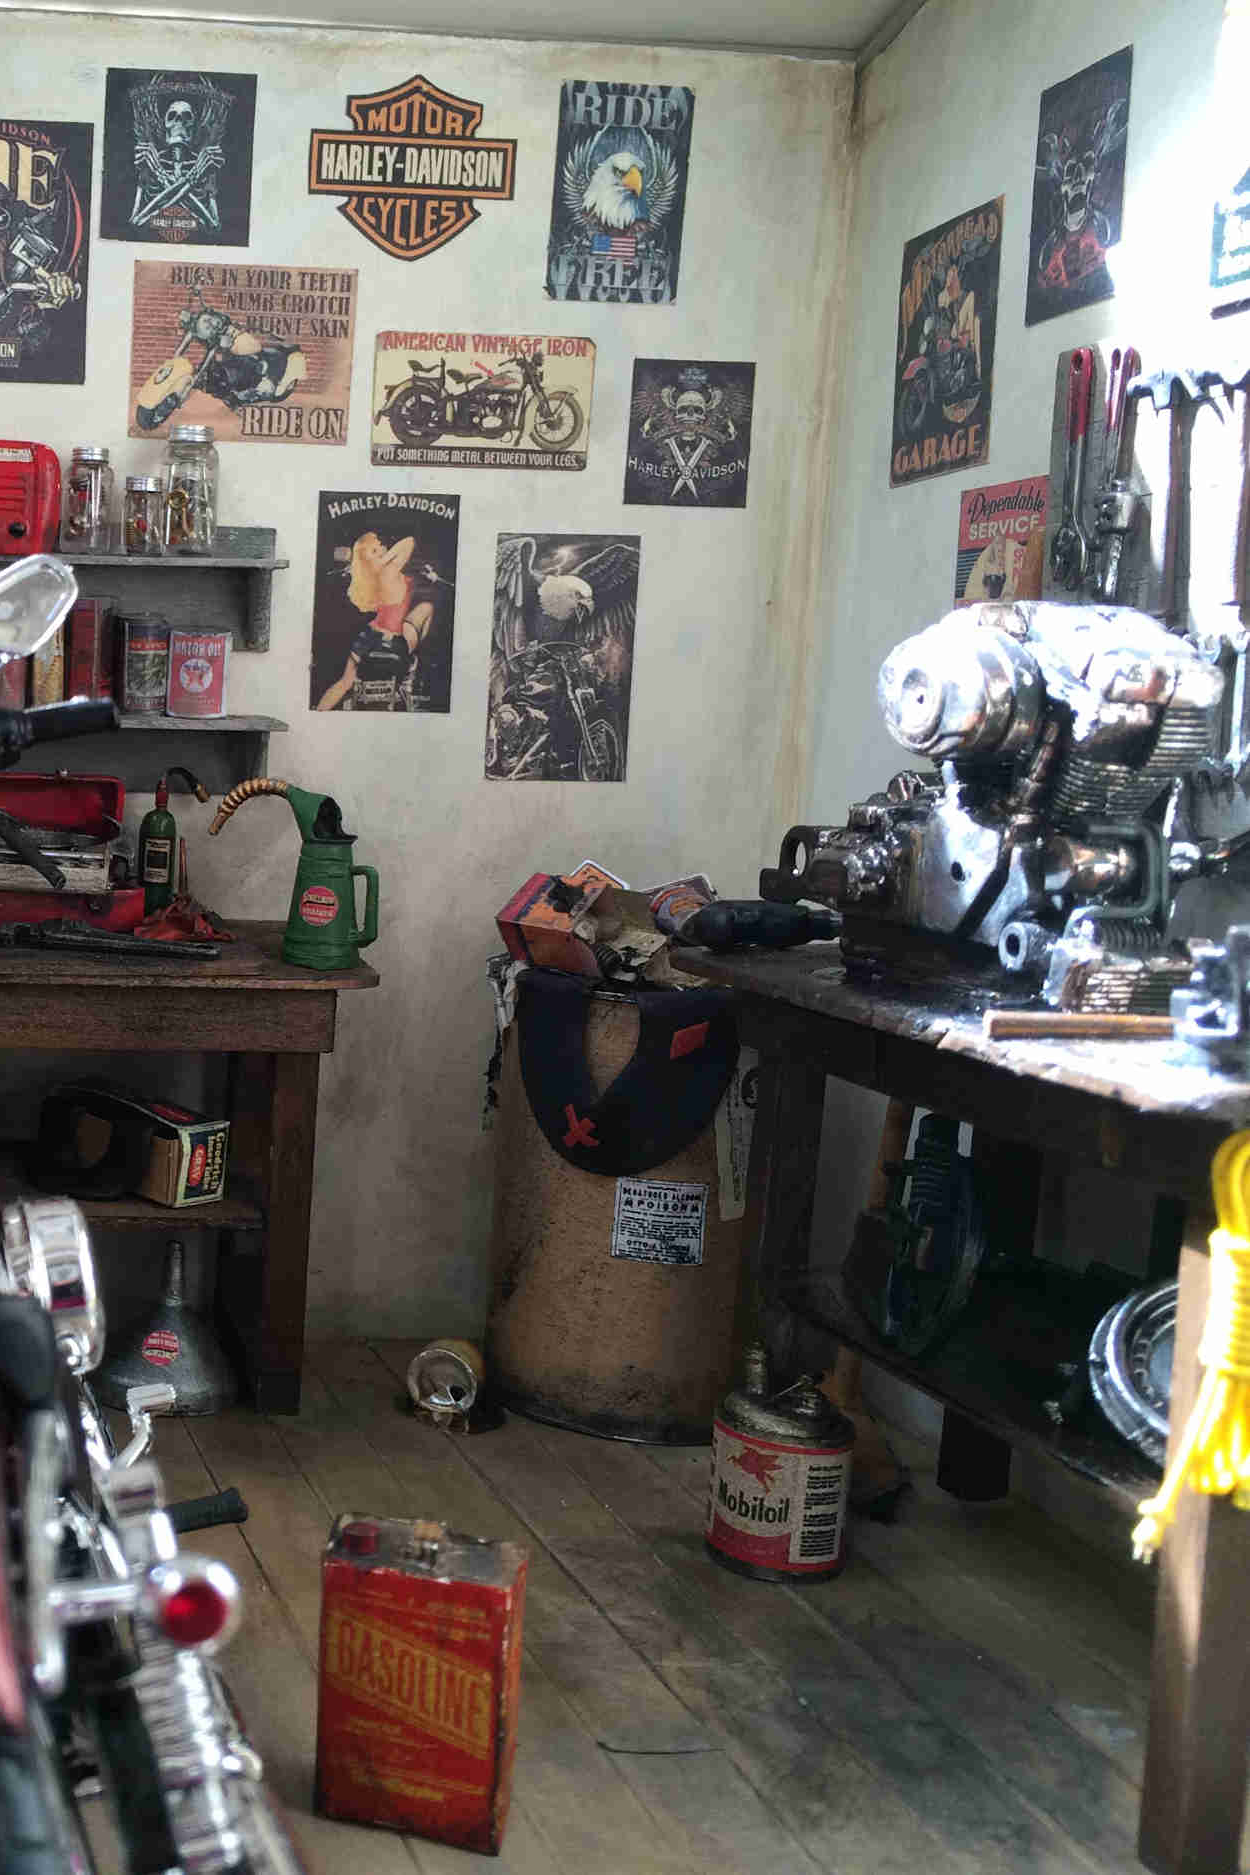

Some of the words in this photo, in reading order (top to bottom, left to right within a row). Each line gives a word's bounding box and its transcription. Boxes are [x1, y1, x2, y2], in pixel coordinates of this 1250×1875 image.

[367, 94, 463, 136] MOTOR
[573, 92, 677, 130] RIDE
[321, 143, 504, 188] HARLEY-DAVIDSON
[363, 197, 457, 246] CYCLES
[171, 266, 215, 286] BUGS
[221, 267, 239, 288] IN
[246, 269, 291, 290] YOUR
[299, 272, 351, 292] TEETH
[310, 318, 349, 338] SKIN
[381, 334, 466, 353] AMERICAN
[472, 335, 543, 356] VINTAGE
[547, 338, 589, 357] IRON
[240, 406, 303, 437] RIDE
[309, 409, 344, 440] ON
[377, 448, 395, 460] PUT
[397, 448, 449, 463] SOMETHING
[451, 450, 482, 464] METAL
[484, 451, 526, 465] BETWEEN
[528, 452, 553, 466] YOUR
[893, 424, 982, 474] GARAGE
[327, 494, 455, 520] HARLEY-DAVIDSON
[968, 481, 1045, 523] Dependable
[969, 514, 1042, 540] SERVICE
[718, 1478, 791, 1523] Mobiloil
